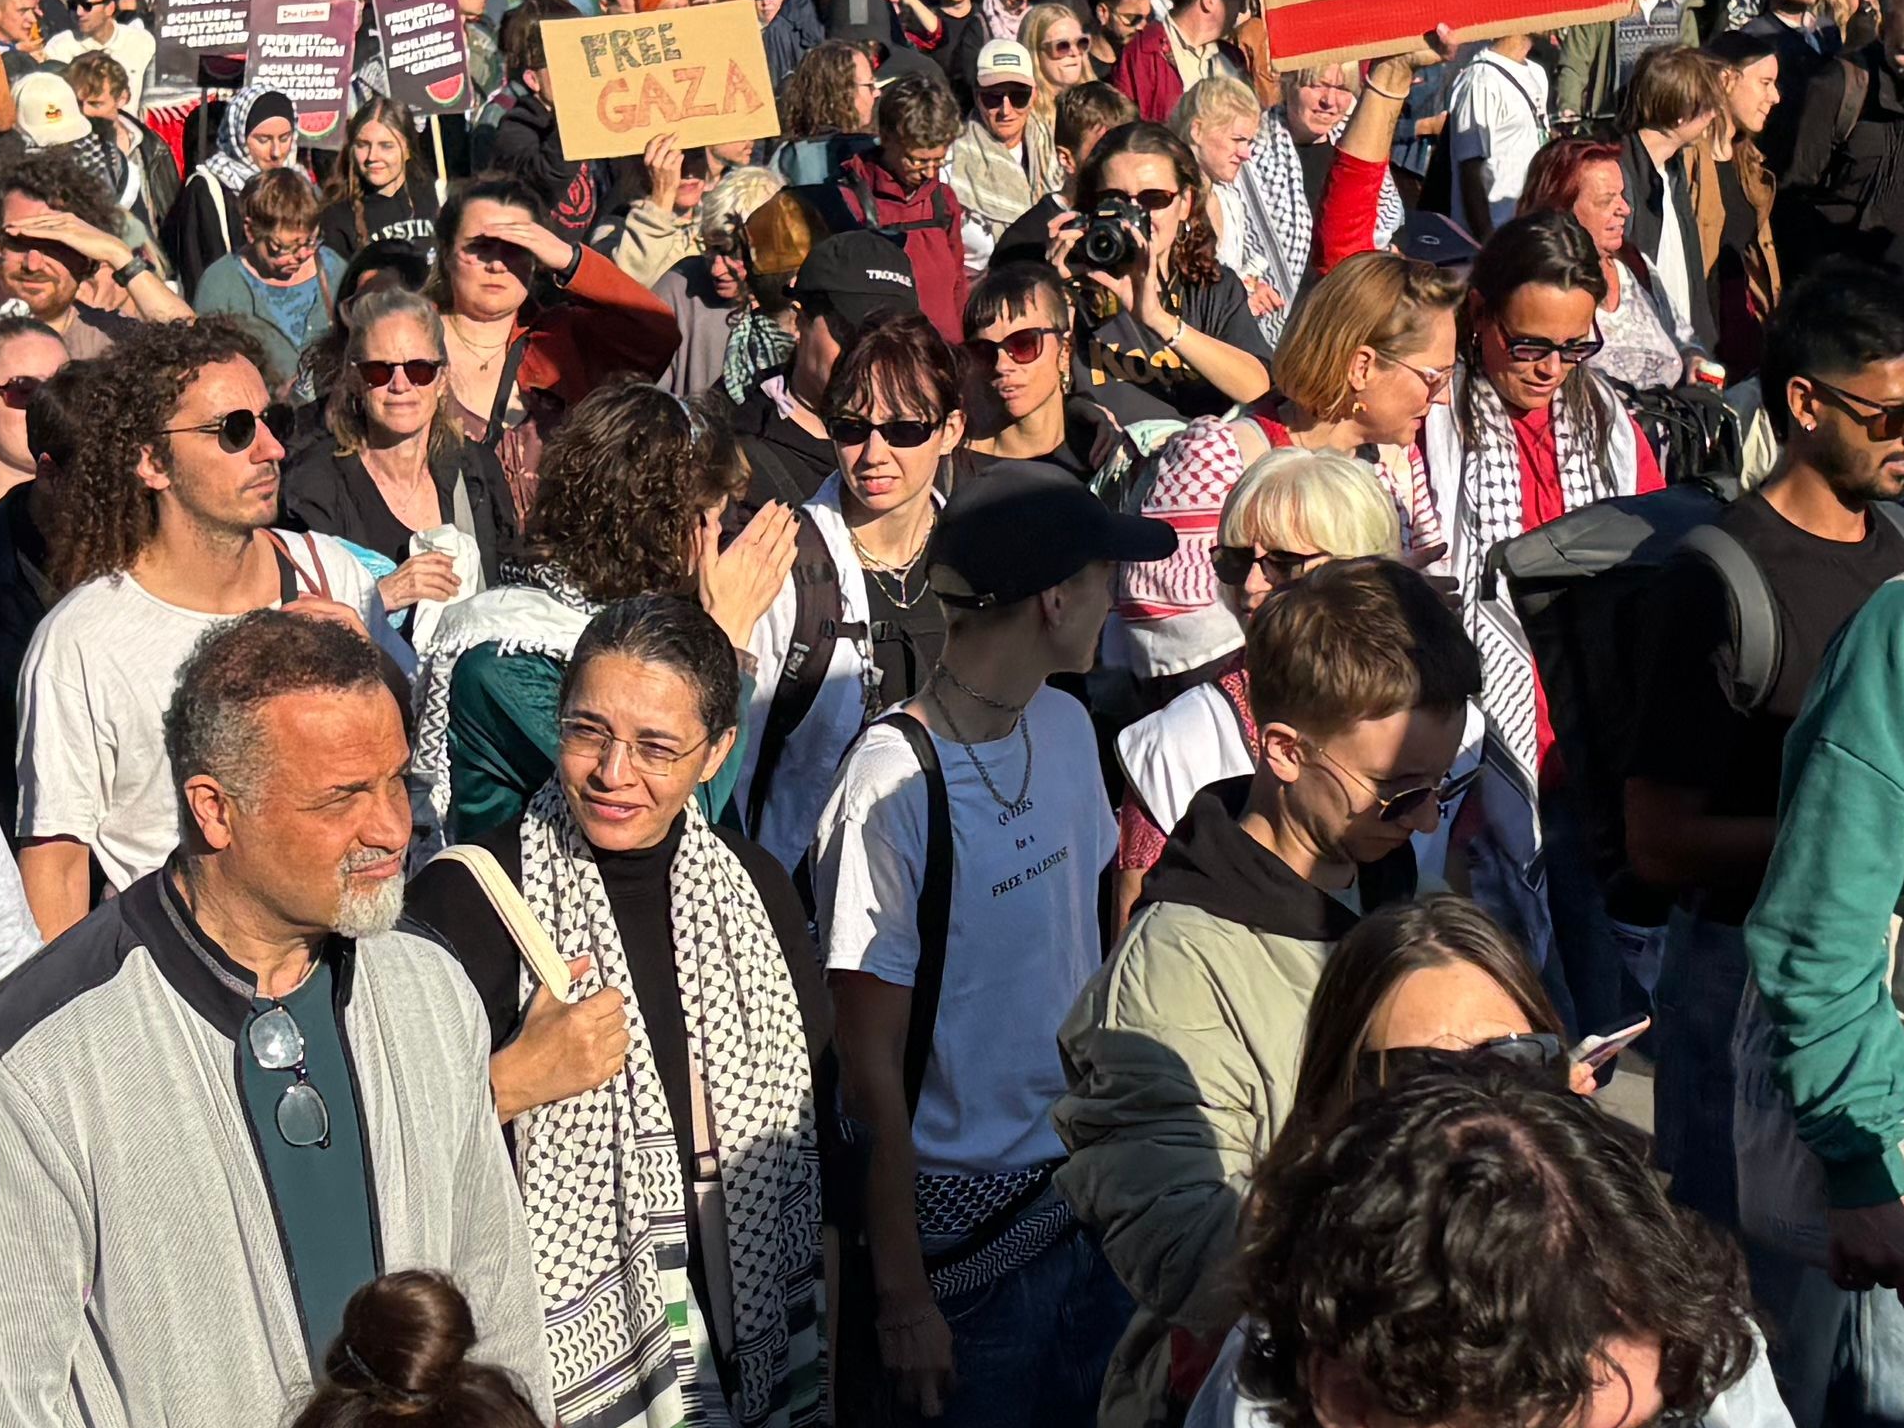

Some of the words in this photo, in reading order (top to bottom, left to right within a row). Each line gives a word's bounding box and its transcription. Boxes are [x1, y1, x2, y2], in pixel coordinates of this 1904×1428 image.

[167, 9, 231, 25] SCHLUSS
[161, 20, 244, 38] BESATZUNG
[257, 34, 323, 46] FREIHEIT
[580, 23, 681, 78] FREE
[258, 63, 323, 76] SCHLUSS
[597, 58, 764, 133] GAZA
[992, 874, 1023, 897] FREE
